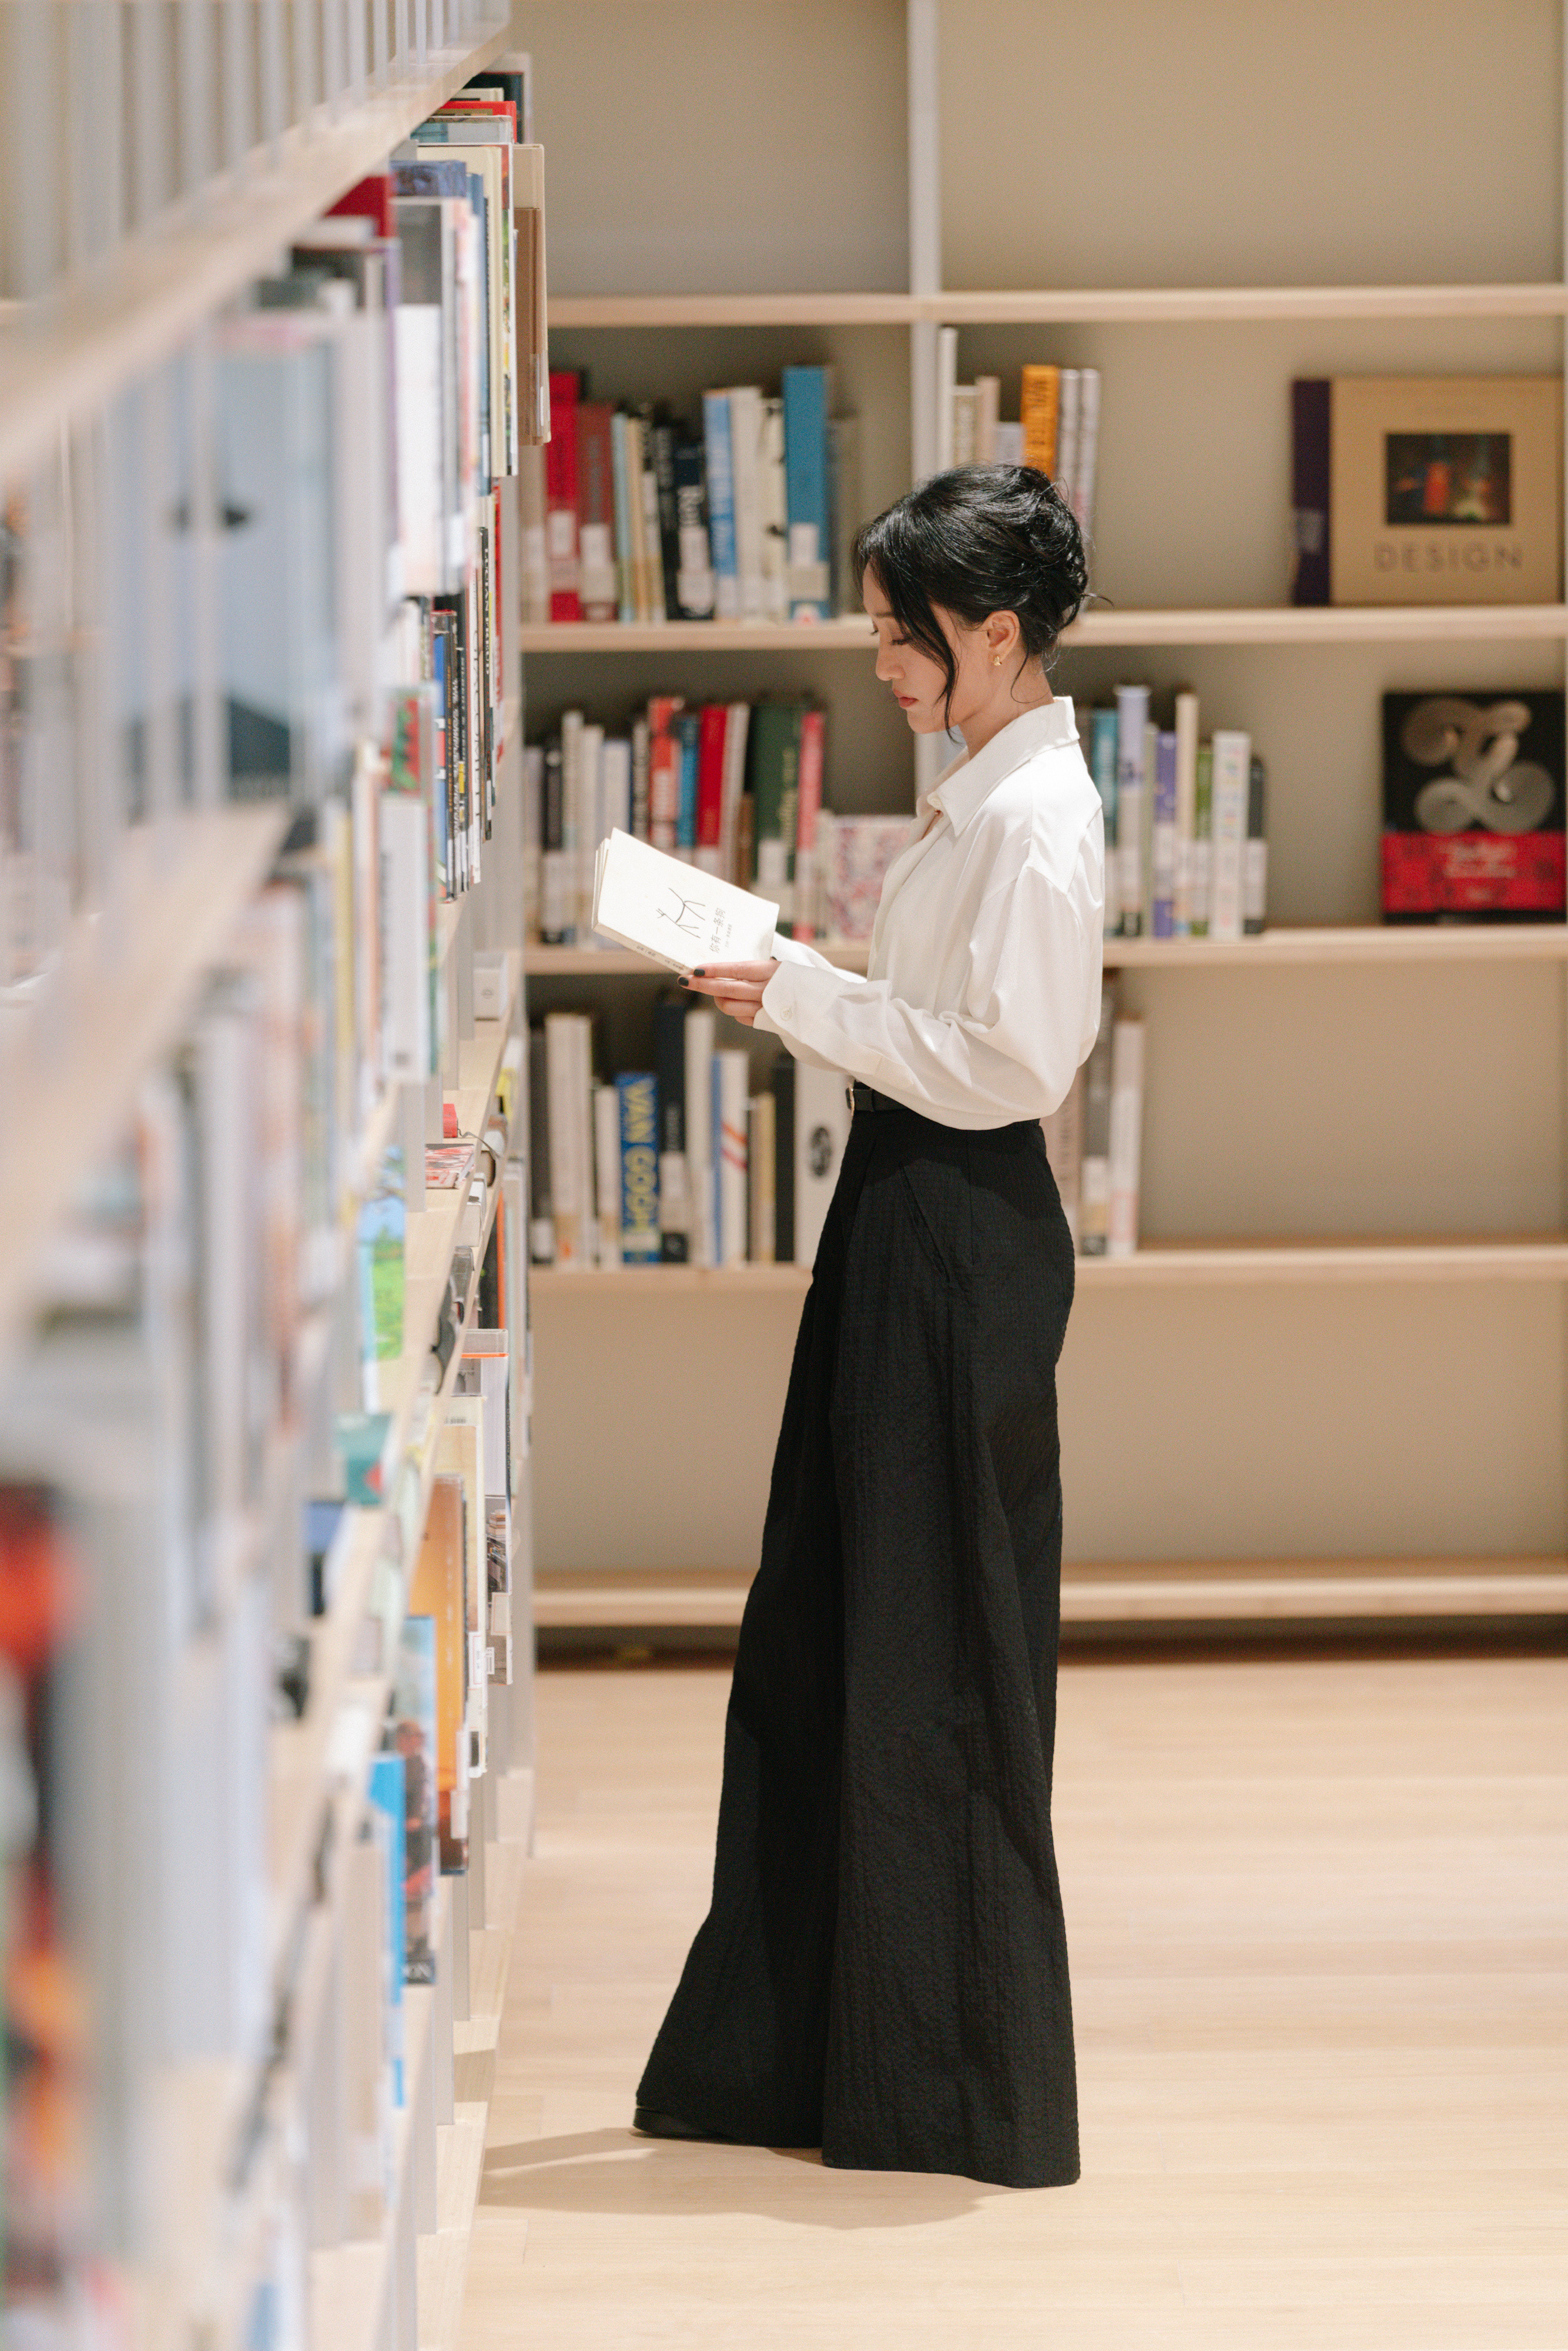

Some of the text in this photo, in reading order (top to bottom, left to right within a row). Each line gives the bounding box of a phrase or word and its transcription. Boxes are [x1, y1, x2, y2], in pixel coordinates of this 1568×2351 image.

[1374, 541, 1523, 574] DESIGN
[709, 907, 726, 953] 你有一条狗
[624, 1076, 656, 1144] VAN
